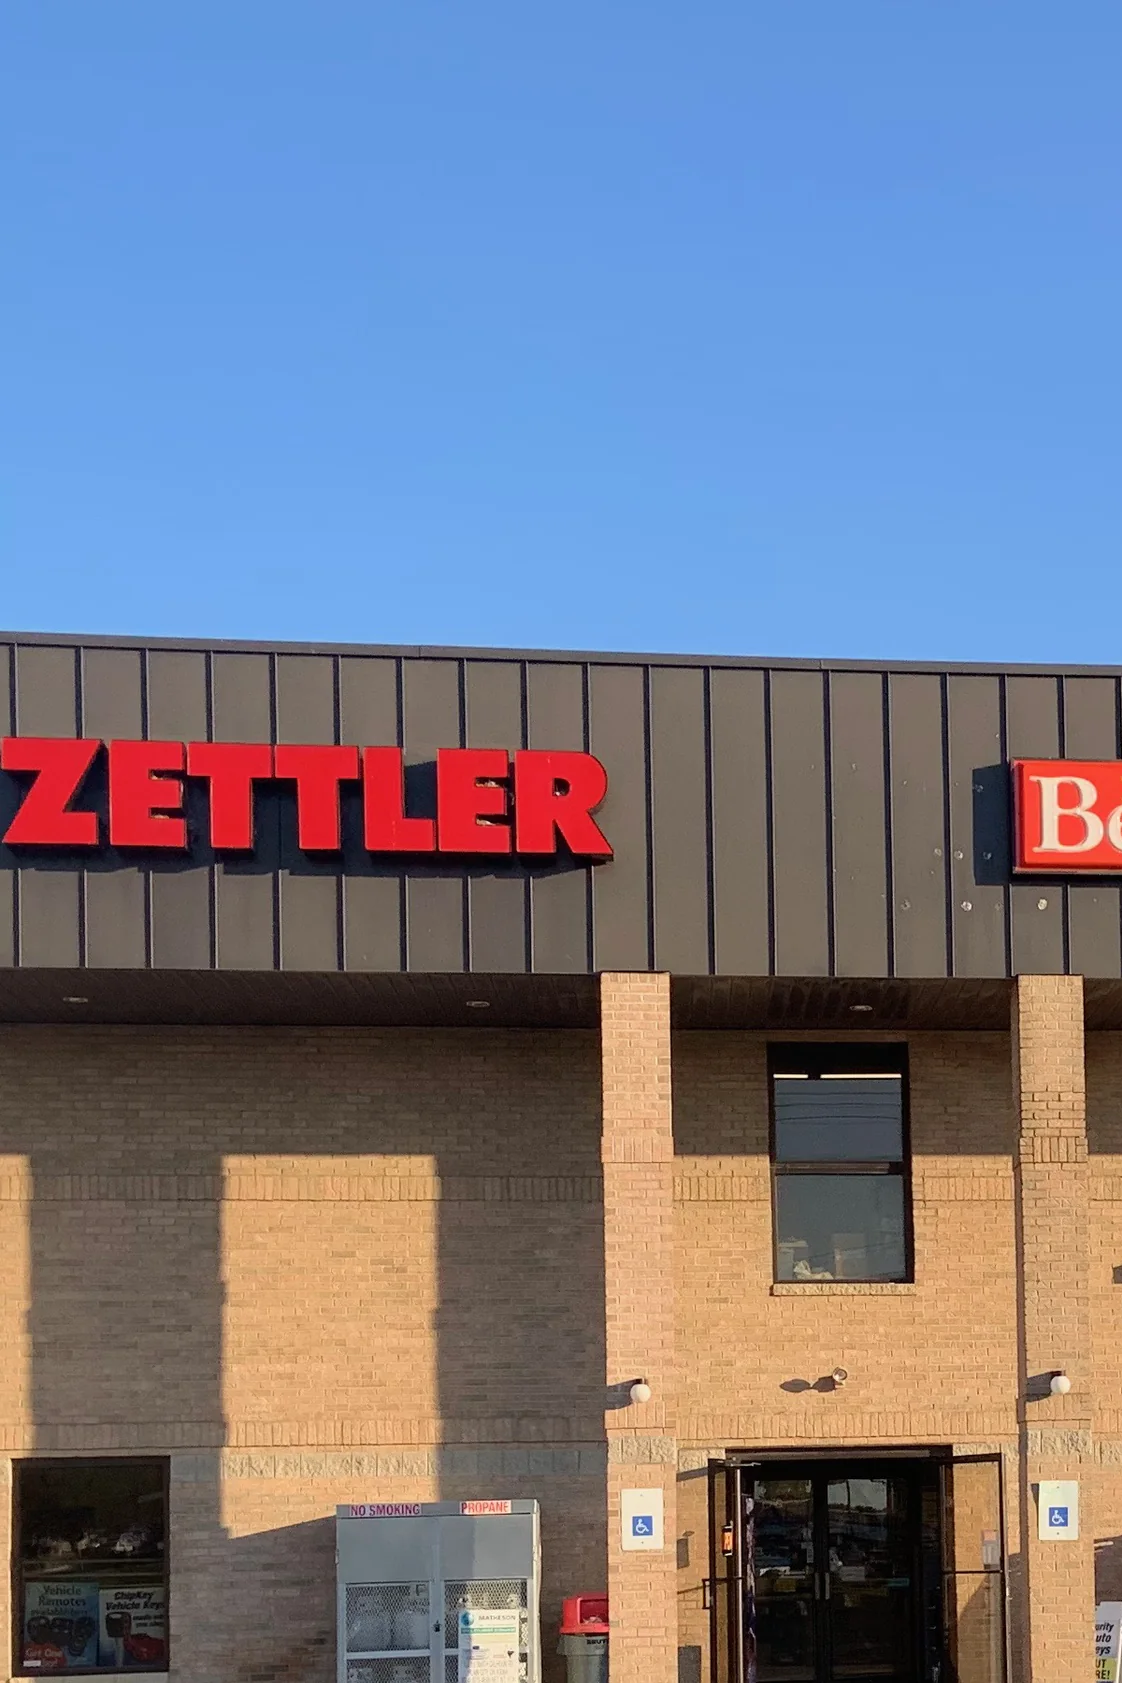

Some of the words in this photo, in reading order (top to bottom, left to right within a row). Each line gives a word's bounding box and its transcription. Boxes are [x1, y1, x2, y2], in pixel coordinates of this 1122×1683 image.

[2, 737, 613, 856] ZETTLER
[351, 1504, 366, 1516] NO
[369, 1503, 420, 1516] SMOKING
[461, 1501, 509, 1513] PROPANE
[1095, 1622, 1114, 1632] urity
[1095, 1633, 1111, 1642] uto
[1095, 1646, 1111, 1656] eys
[1095, 1659, 1106, 1668] UT
[1095, 1670, 1110, 1680] RE!
